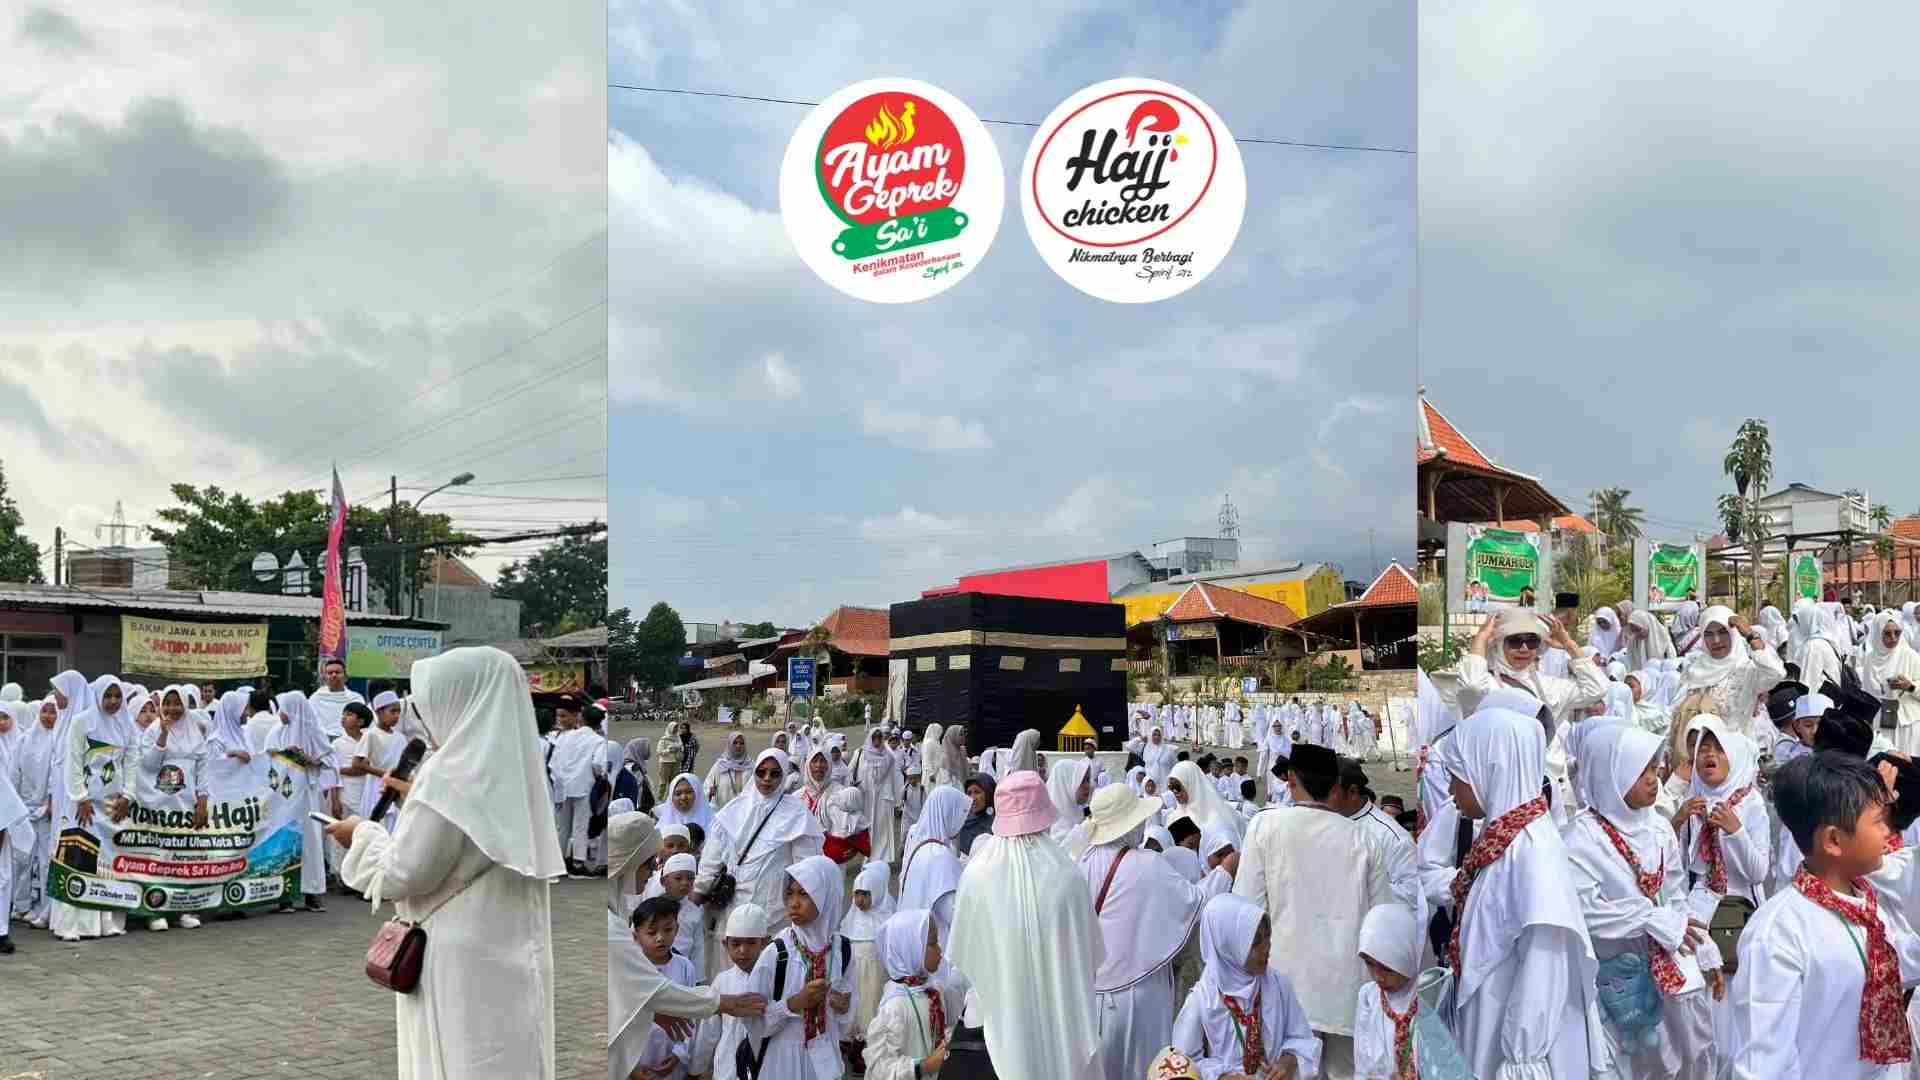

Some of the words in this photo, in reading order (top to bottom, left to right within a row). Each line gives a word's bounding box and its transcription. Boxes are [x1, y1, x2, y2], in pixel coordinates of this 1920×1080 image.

[131, 623, 165, 634] BAKMI
[168, 626, 196, 636] JAWA
[211, 629, 235, 638] RICA
[237, 628, 260, 637] RICA
[212, 796, 260, 831] Haji
[117, 858, 146, 873] Ayam
[148, 861, 190, 876] Geprek
